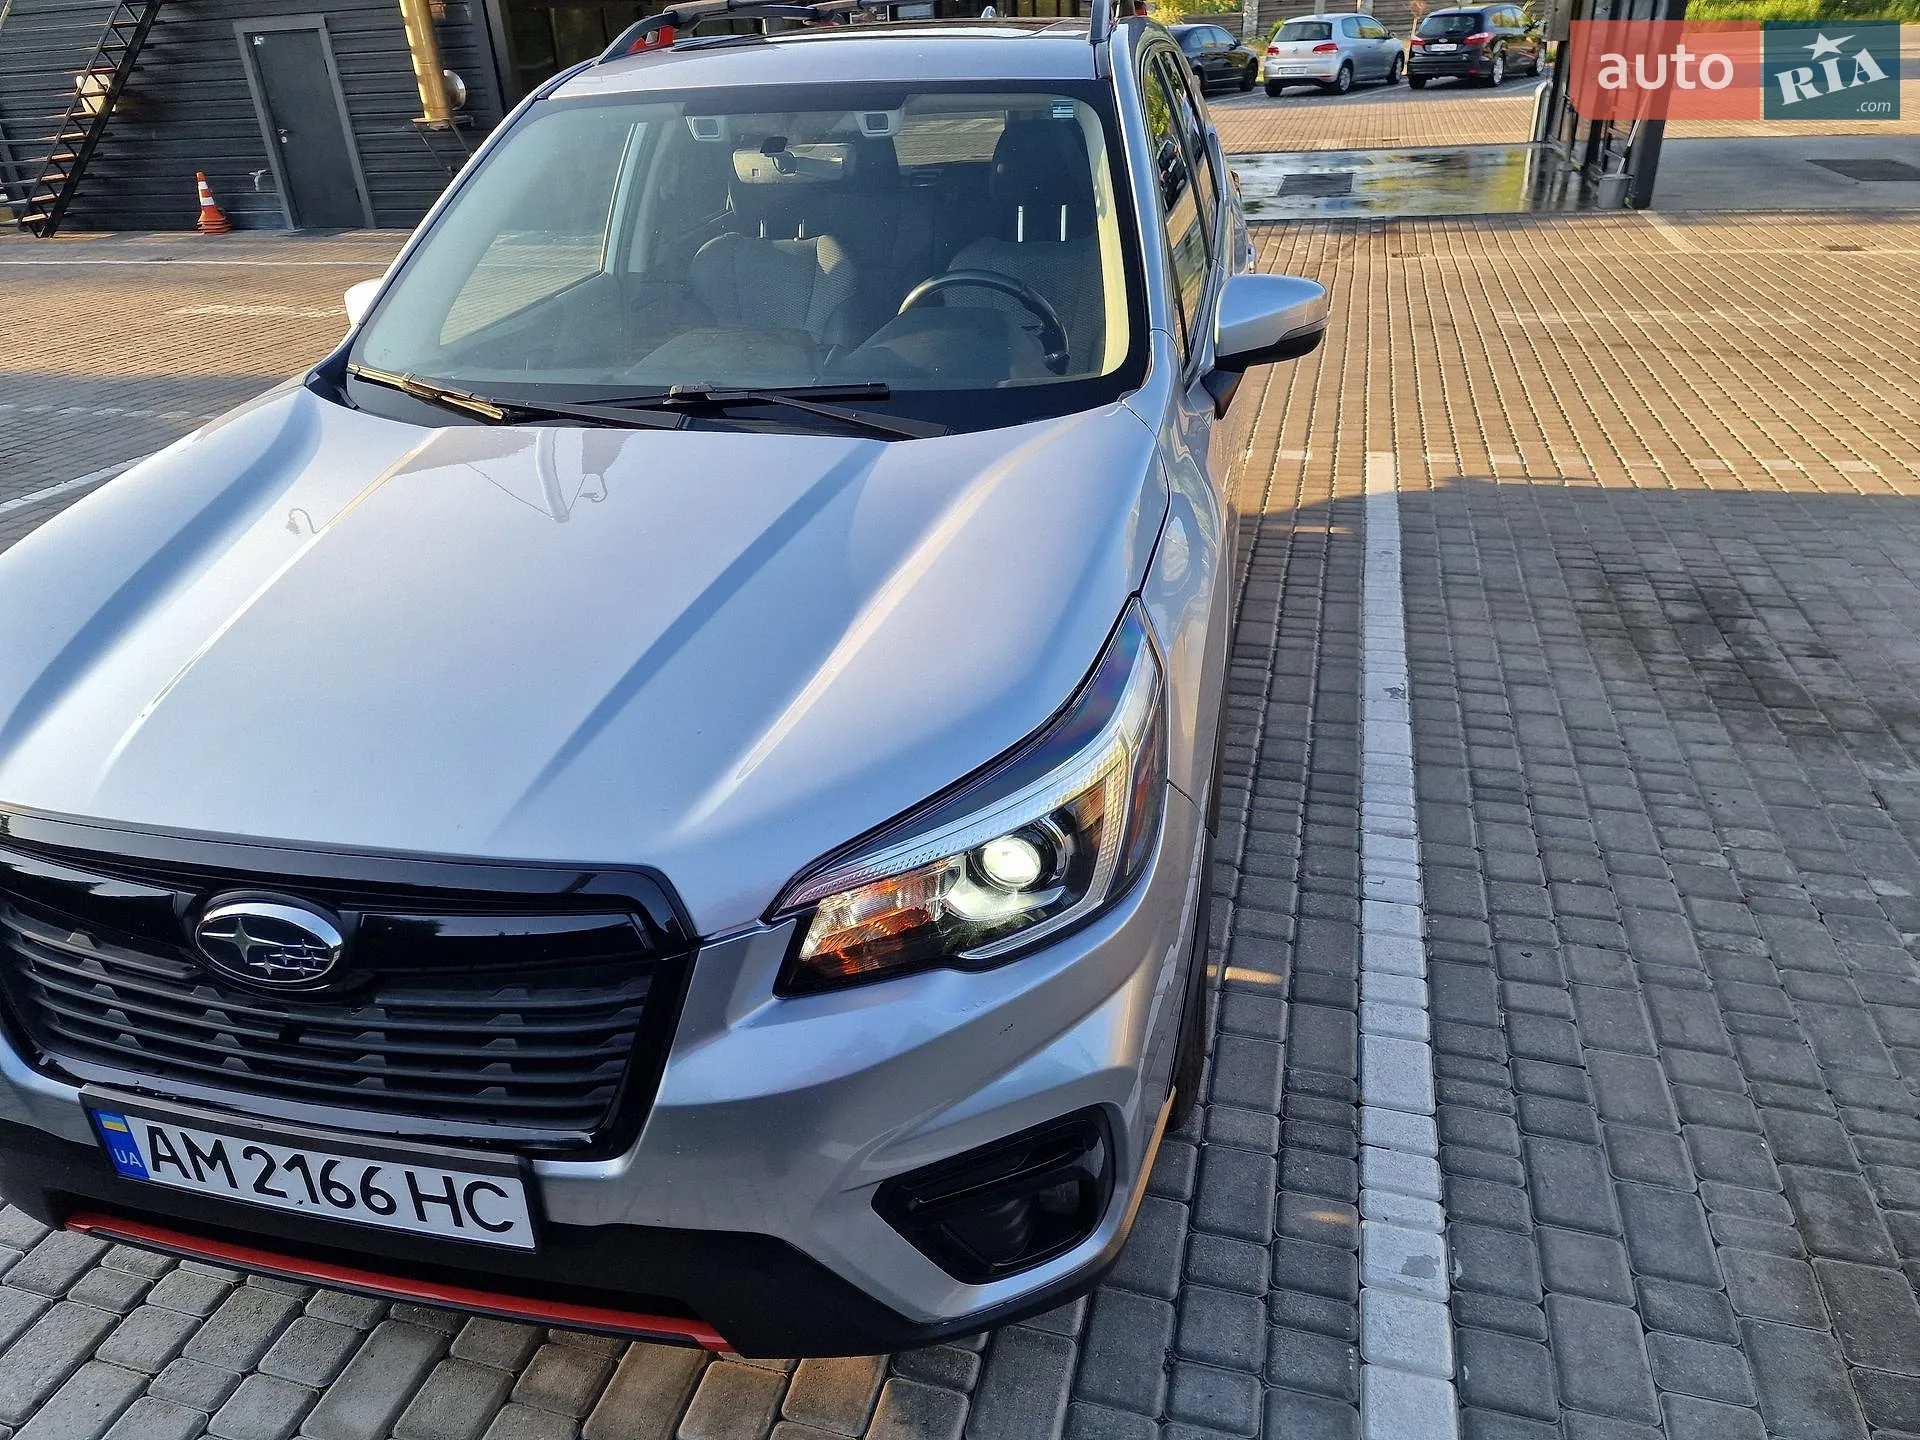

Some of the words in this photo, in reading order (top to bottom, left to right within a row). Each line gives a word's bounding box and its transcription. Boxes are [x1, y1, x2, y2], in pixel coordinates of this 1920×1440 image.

[114, 1148, 142, 1168] UA
[146, 1125, 239, 1189] AM
[242, 1145, 397, 1216] 2166
[404, 1170, 515, 1233] HC
